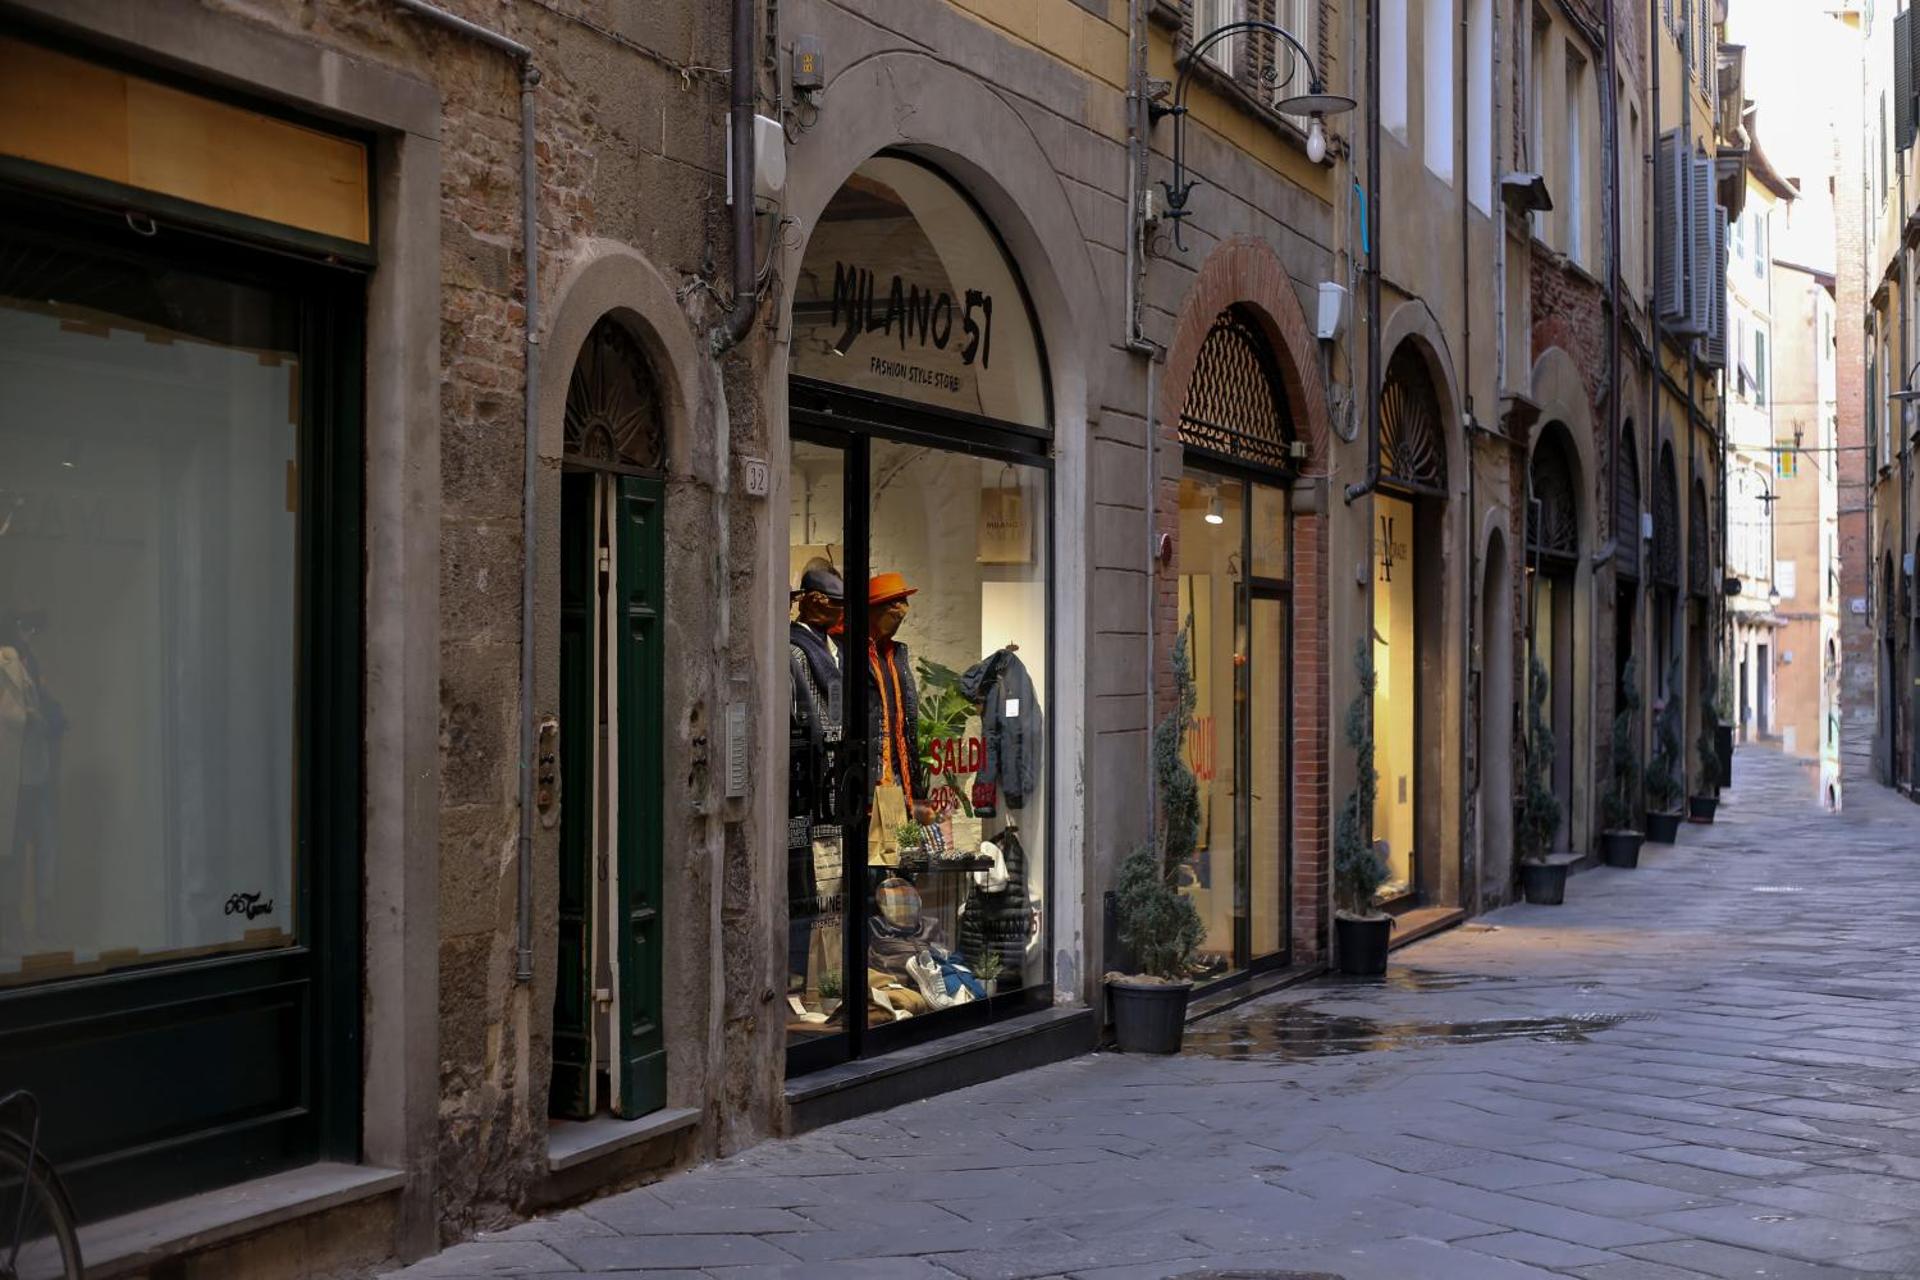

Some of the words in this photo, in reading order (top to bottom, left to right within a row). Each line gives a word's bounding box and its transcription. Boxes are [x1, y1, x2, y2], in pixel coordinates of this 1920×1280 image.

[833, 261, 953, 350] MILANO
[962, 288, 992, 370] 51
[870, 356, 907, 381] FASHION
[908, 366, 933, 386] STYLE
[934, 373, 960, 393] STORE
[750, 467, 764, 491] 32
[930, 736, 988, 776] SALDI
[931, 786, 959, 811] 30%
